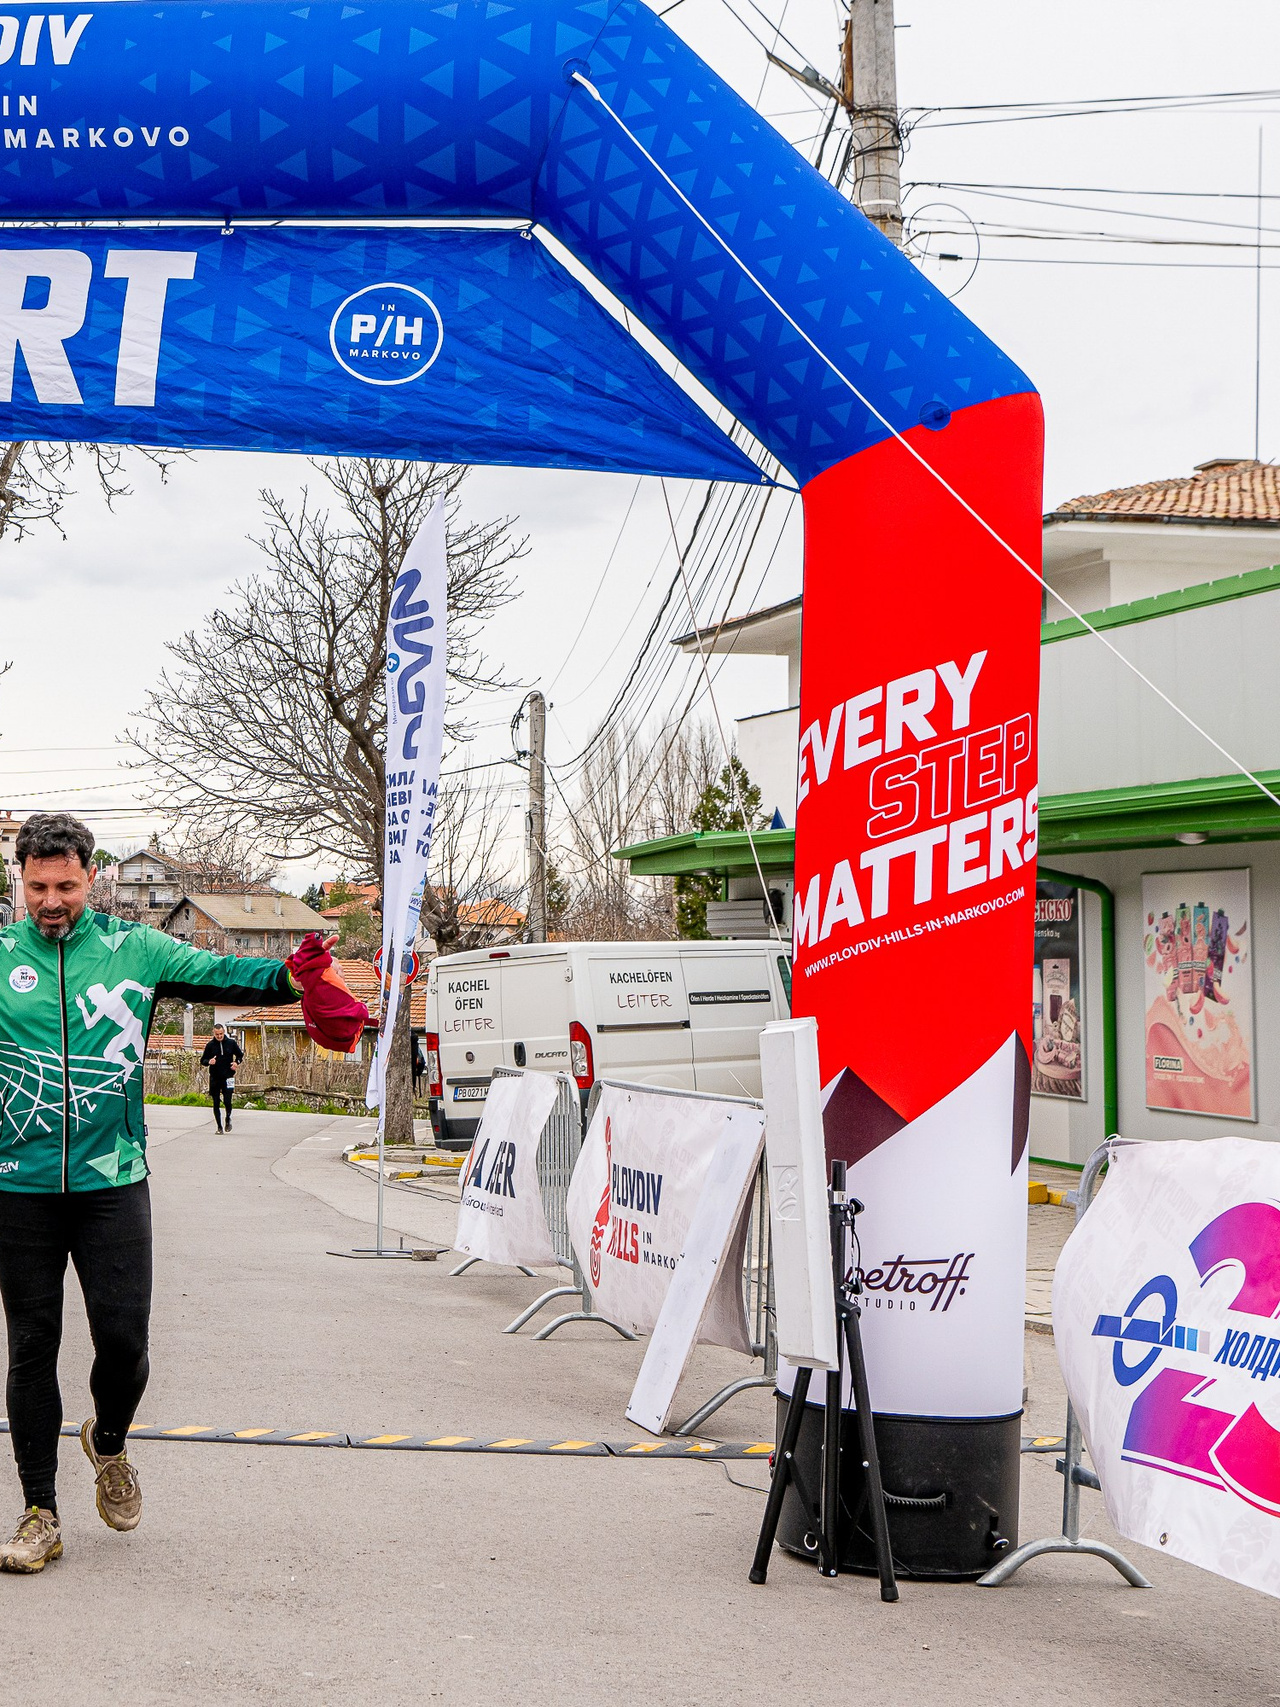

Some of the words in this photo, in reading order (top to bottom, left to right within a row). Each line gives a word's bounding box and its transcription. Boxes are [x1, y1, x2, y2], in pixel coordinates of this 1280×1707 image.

[3, 95, 38, 116] IN
[4, 126, 190, 149] MARKOVO
[350, 314, 423, 347] P/H
[349, 349, 421, 360] MARKOVO
[797, 650, 988, 810] EVERY
[867, 712, 1032, 839] STEP
[793, 783, 1038, 964] MATTERS
[804, 886, 1025, 978] WWW.PLOVDIV-HILLS-IN-MARKOVO.COM
[448, 980, 490, 993] KACHEL
[609, 969, 673, 984] KACHELÖFEN
[455, 997, 483, 1010] ÖFEN
[617, 994, 672, 1008] LEITER
[444, 1018, 495, 1033] LEITER
[612, 1162, 663, 1216] PLOVDIV
[642, 1231, 652, 1245] IN
[643, 1250, 678, 1271] MARKO
[853, 1297, 916, 1311] STUDIO
